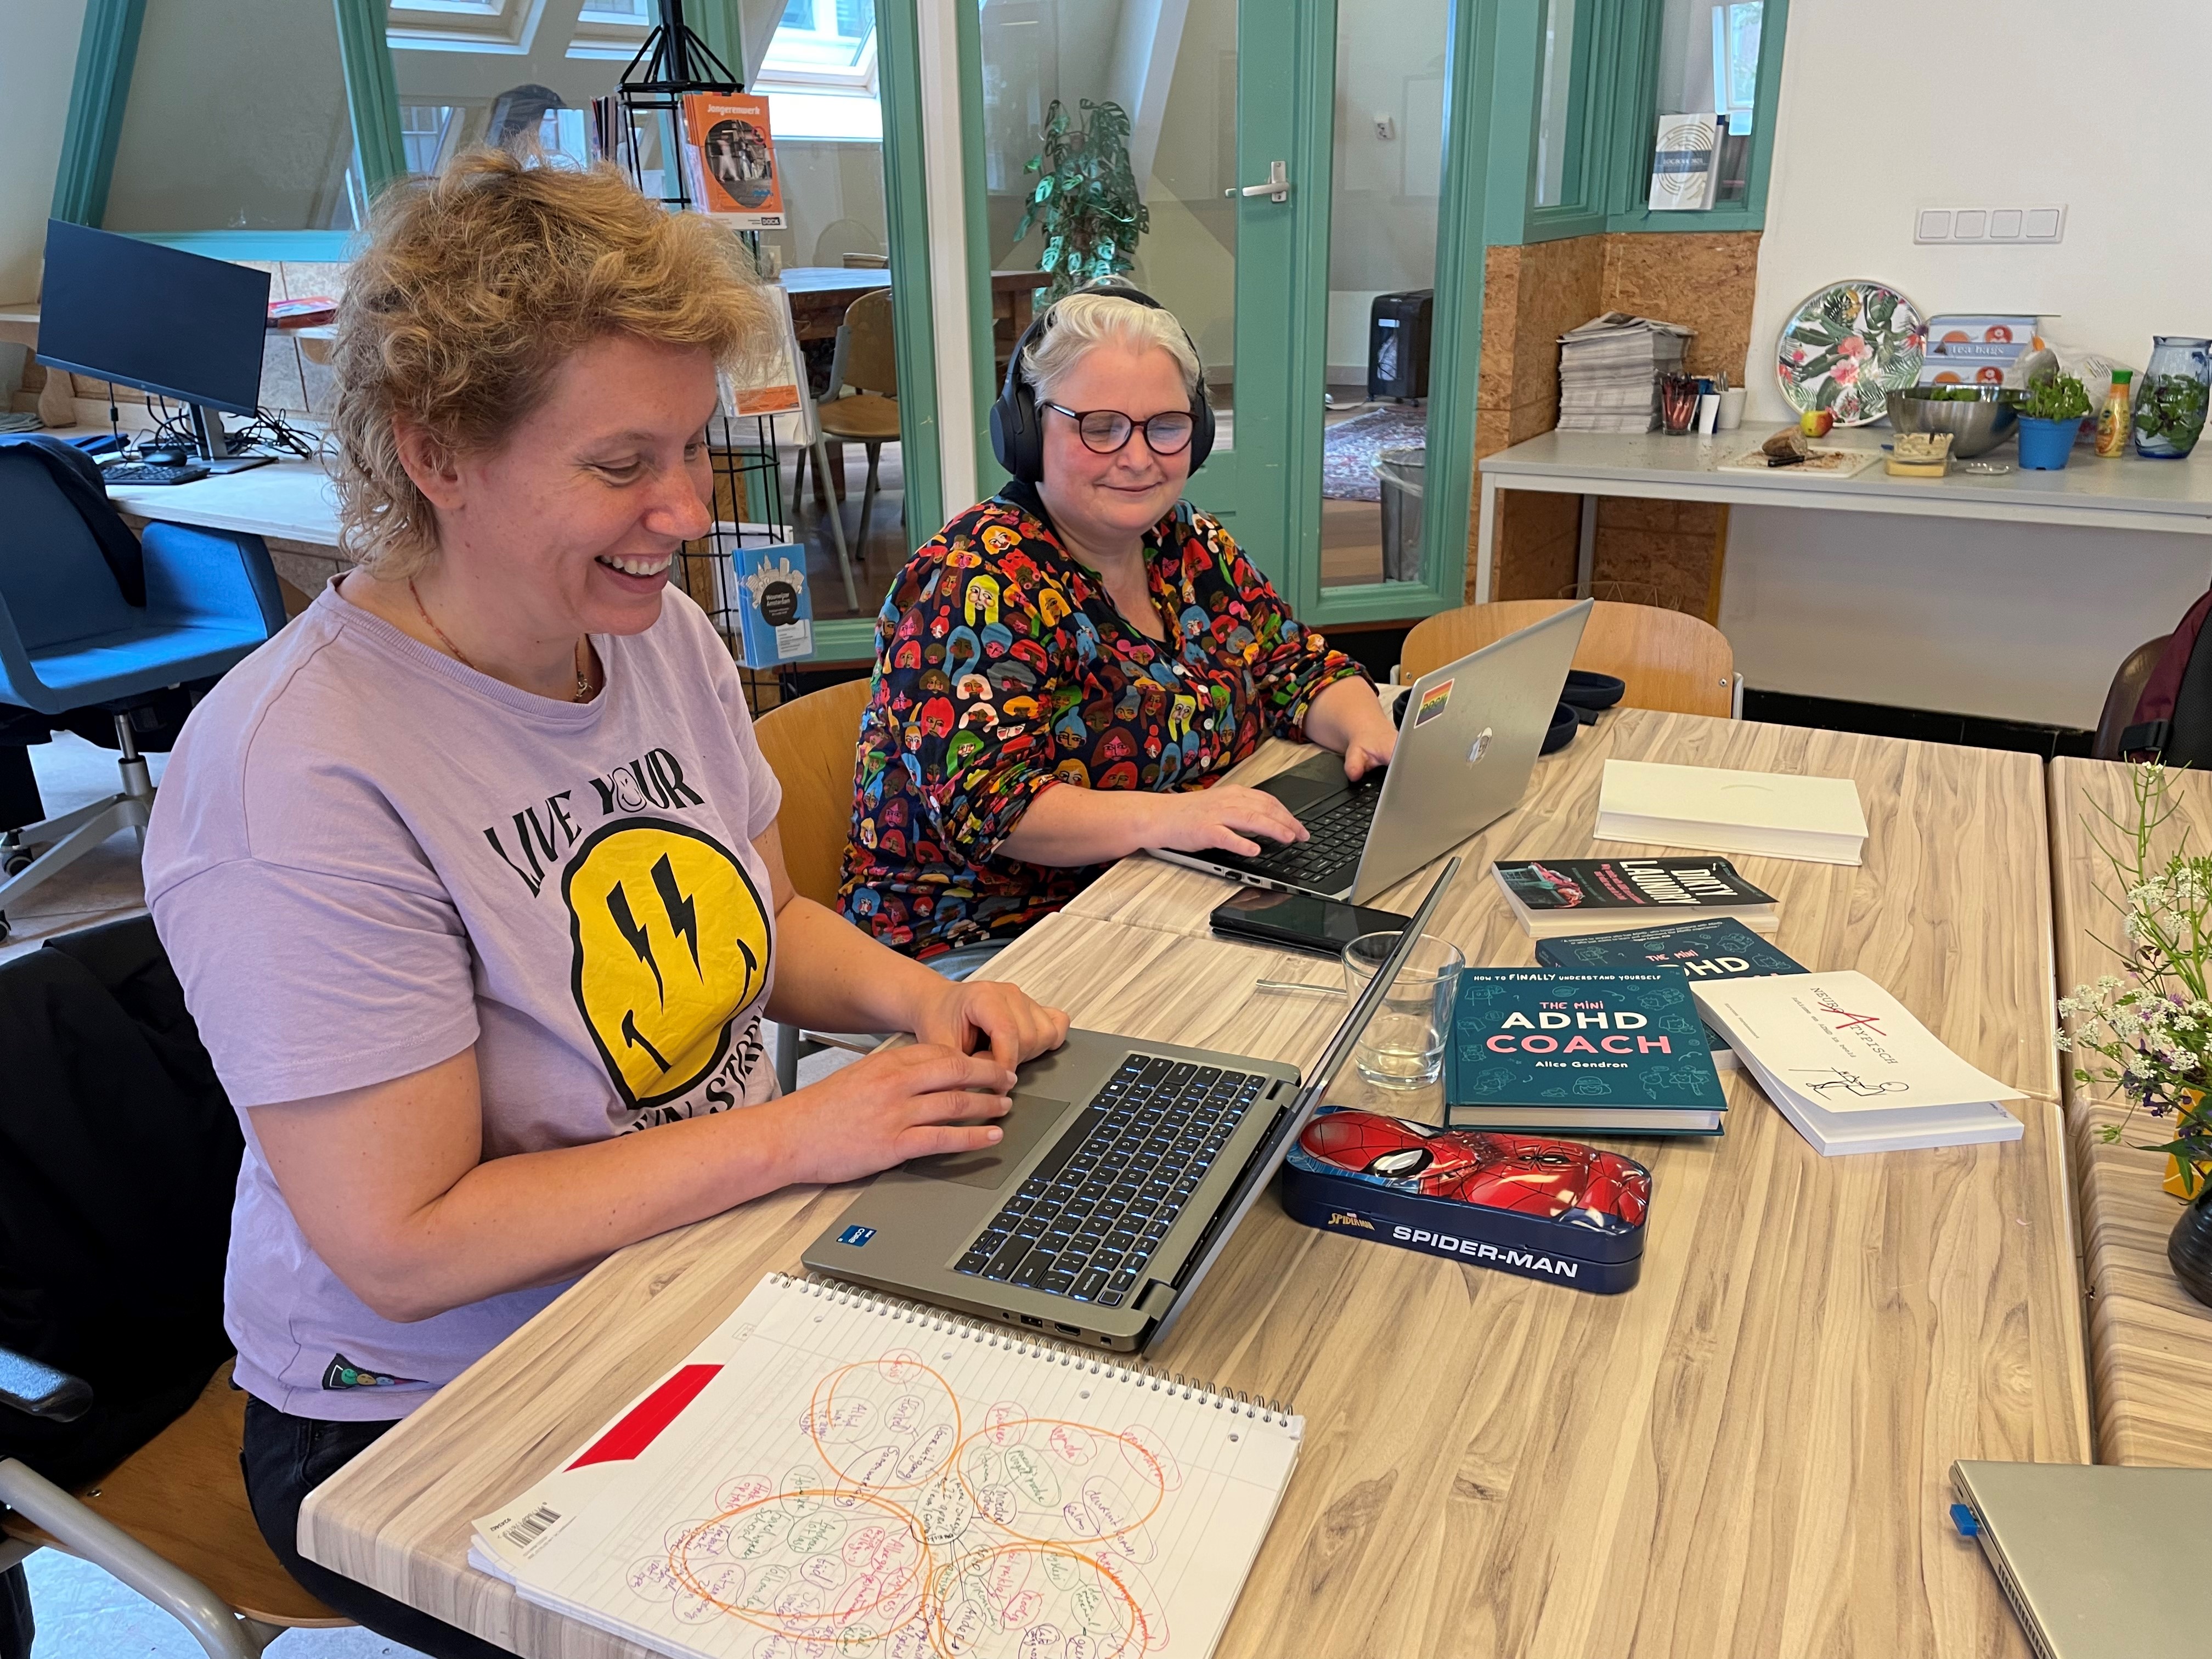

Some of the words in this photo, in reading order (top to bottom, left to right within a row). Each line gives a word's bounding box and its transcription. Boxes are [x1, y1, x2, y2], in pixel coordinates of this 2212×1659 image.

[1952, 345, 1971, 354] tea
[1975, 345, 2004, 356] bags
[483, 790, 583, 899] LIVE
[1620, 861, 1701, 904] LAUNDRY
[1670, 869, 1738, 895] DIRTY
[1500, 1012, 1648, 1030] ADHD
[1486, 1035, 1672, 1054] COACH
[1393, 1226, 1578, 1278] SPIDER-MAN
